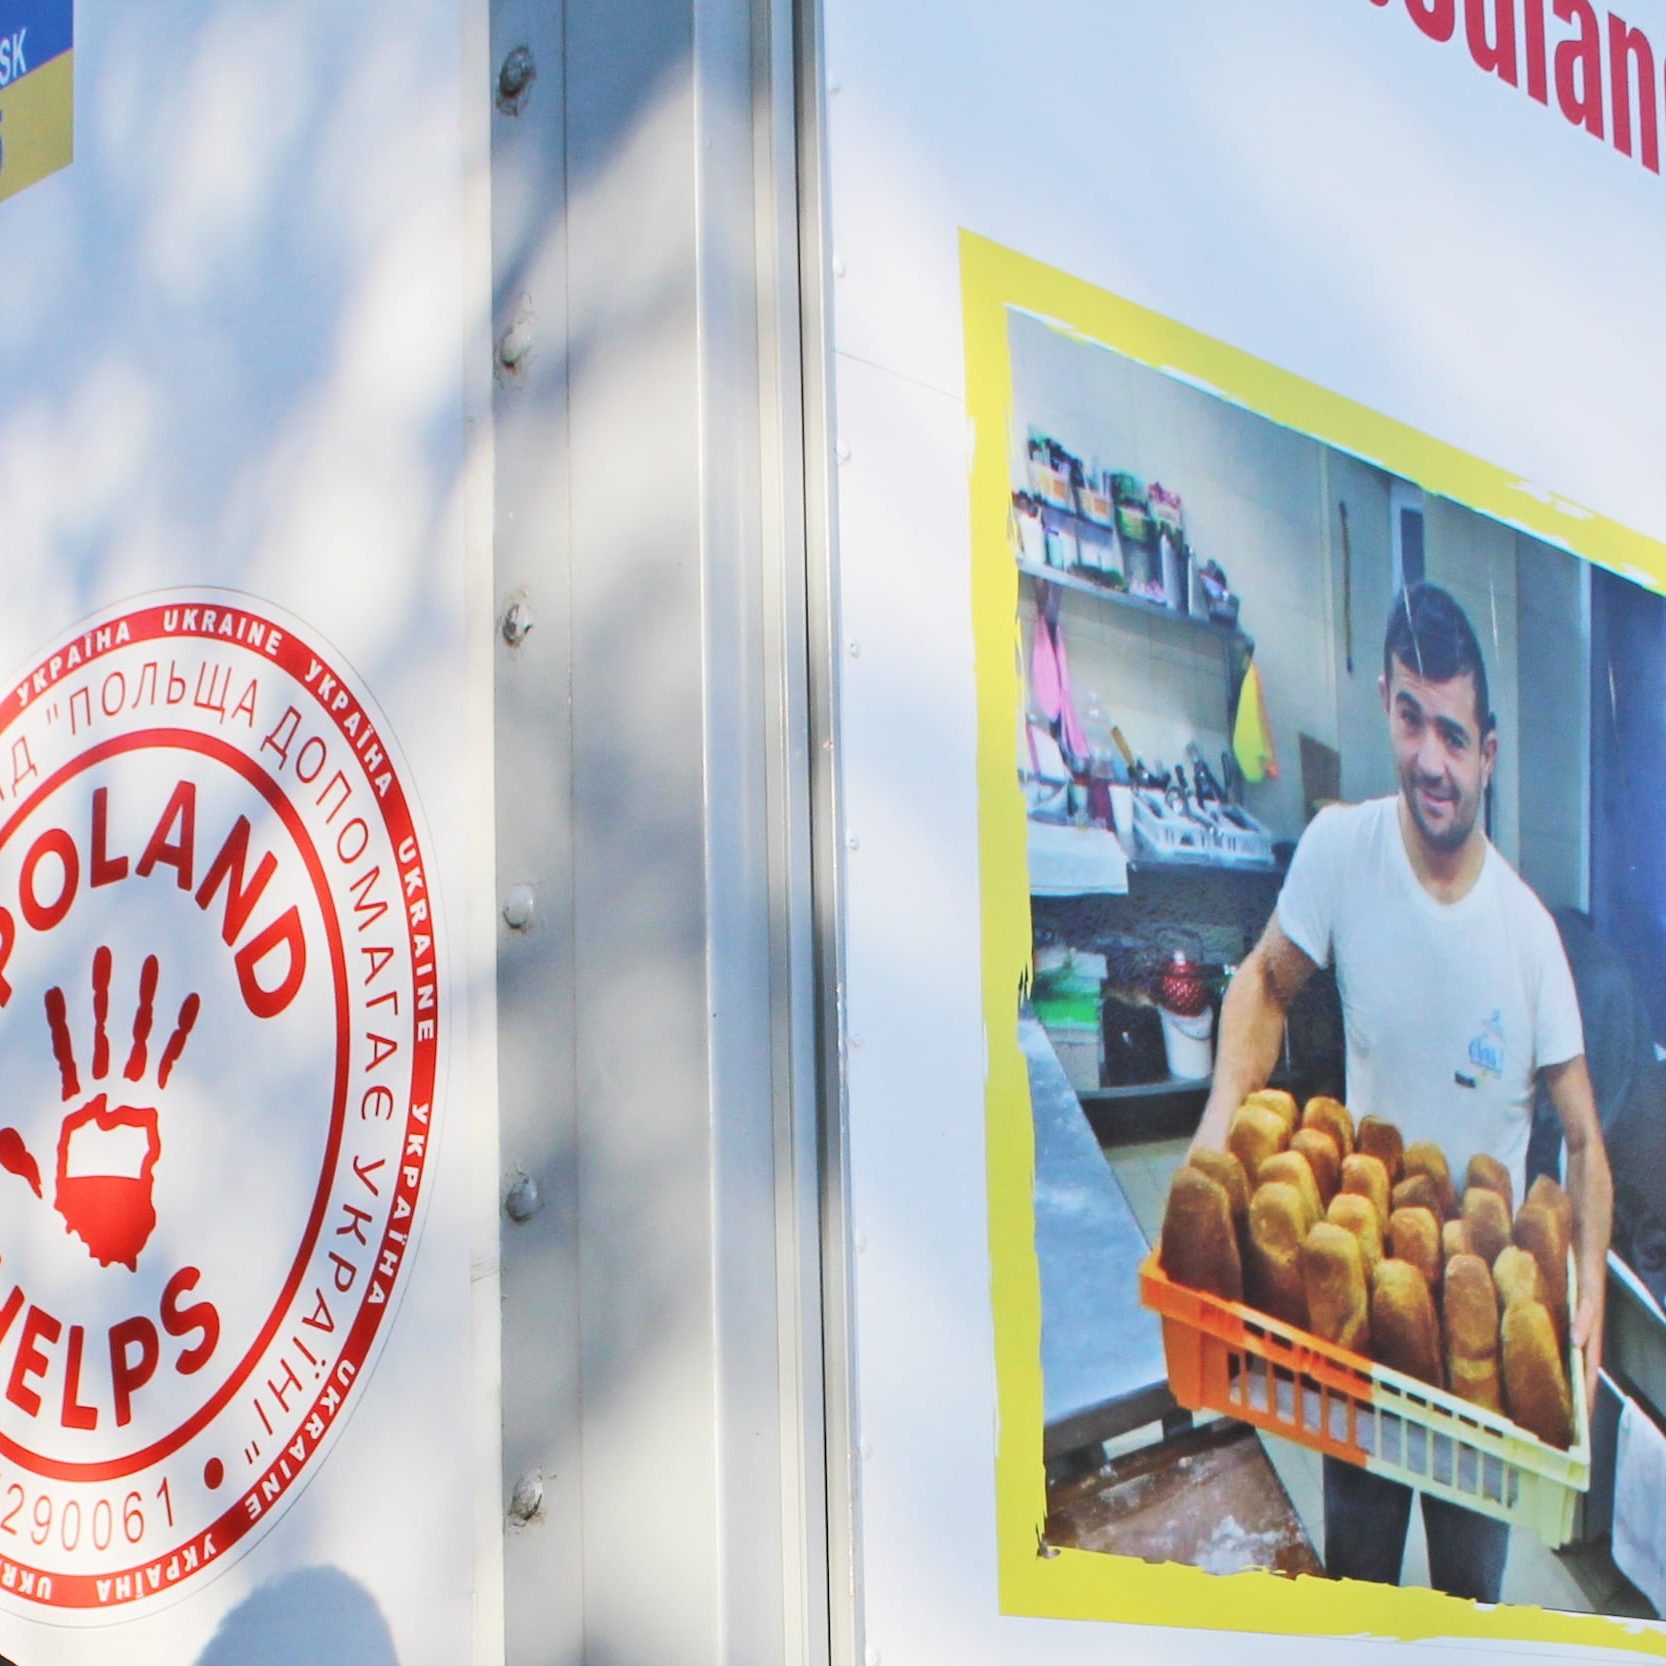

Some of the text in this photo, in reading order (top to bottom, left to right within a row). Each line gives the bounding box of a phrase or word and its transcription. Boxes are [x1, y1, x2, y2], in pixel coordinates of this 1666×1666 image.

[16, 620, 131, 707] УКРАЇНА
[46, 660, 258, 736] "ПОЛЬЩА
[163, 608, 283, 655] UKRAINE
[304, 658, 393, 798] УКРАЇНА
[260, 706, 399, 1120] ДОПОМАГАЄ
[398, 836, 434, 1042] UKRAINE
[368, 1103, 429, 1304] УКРАЇНА
[244, 1155, 386, 1464] УКРАЇНІ"
[245, 1359, 356, 1520] UKRAINE
[96, 1533, 217, 1602] УКРАЇНА
